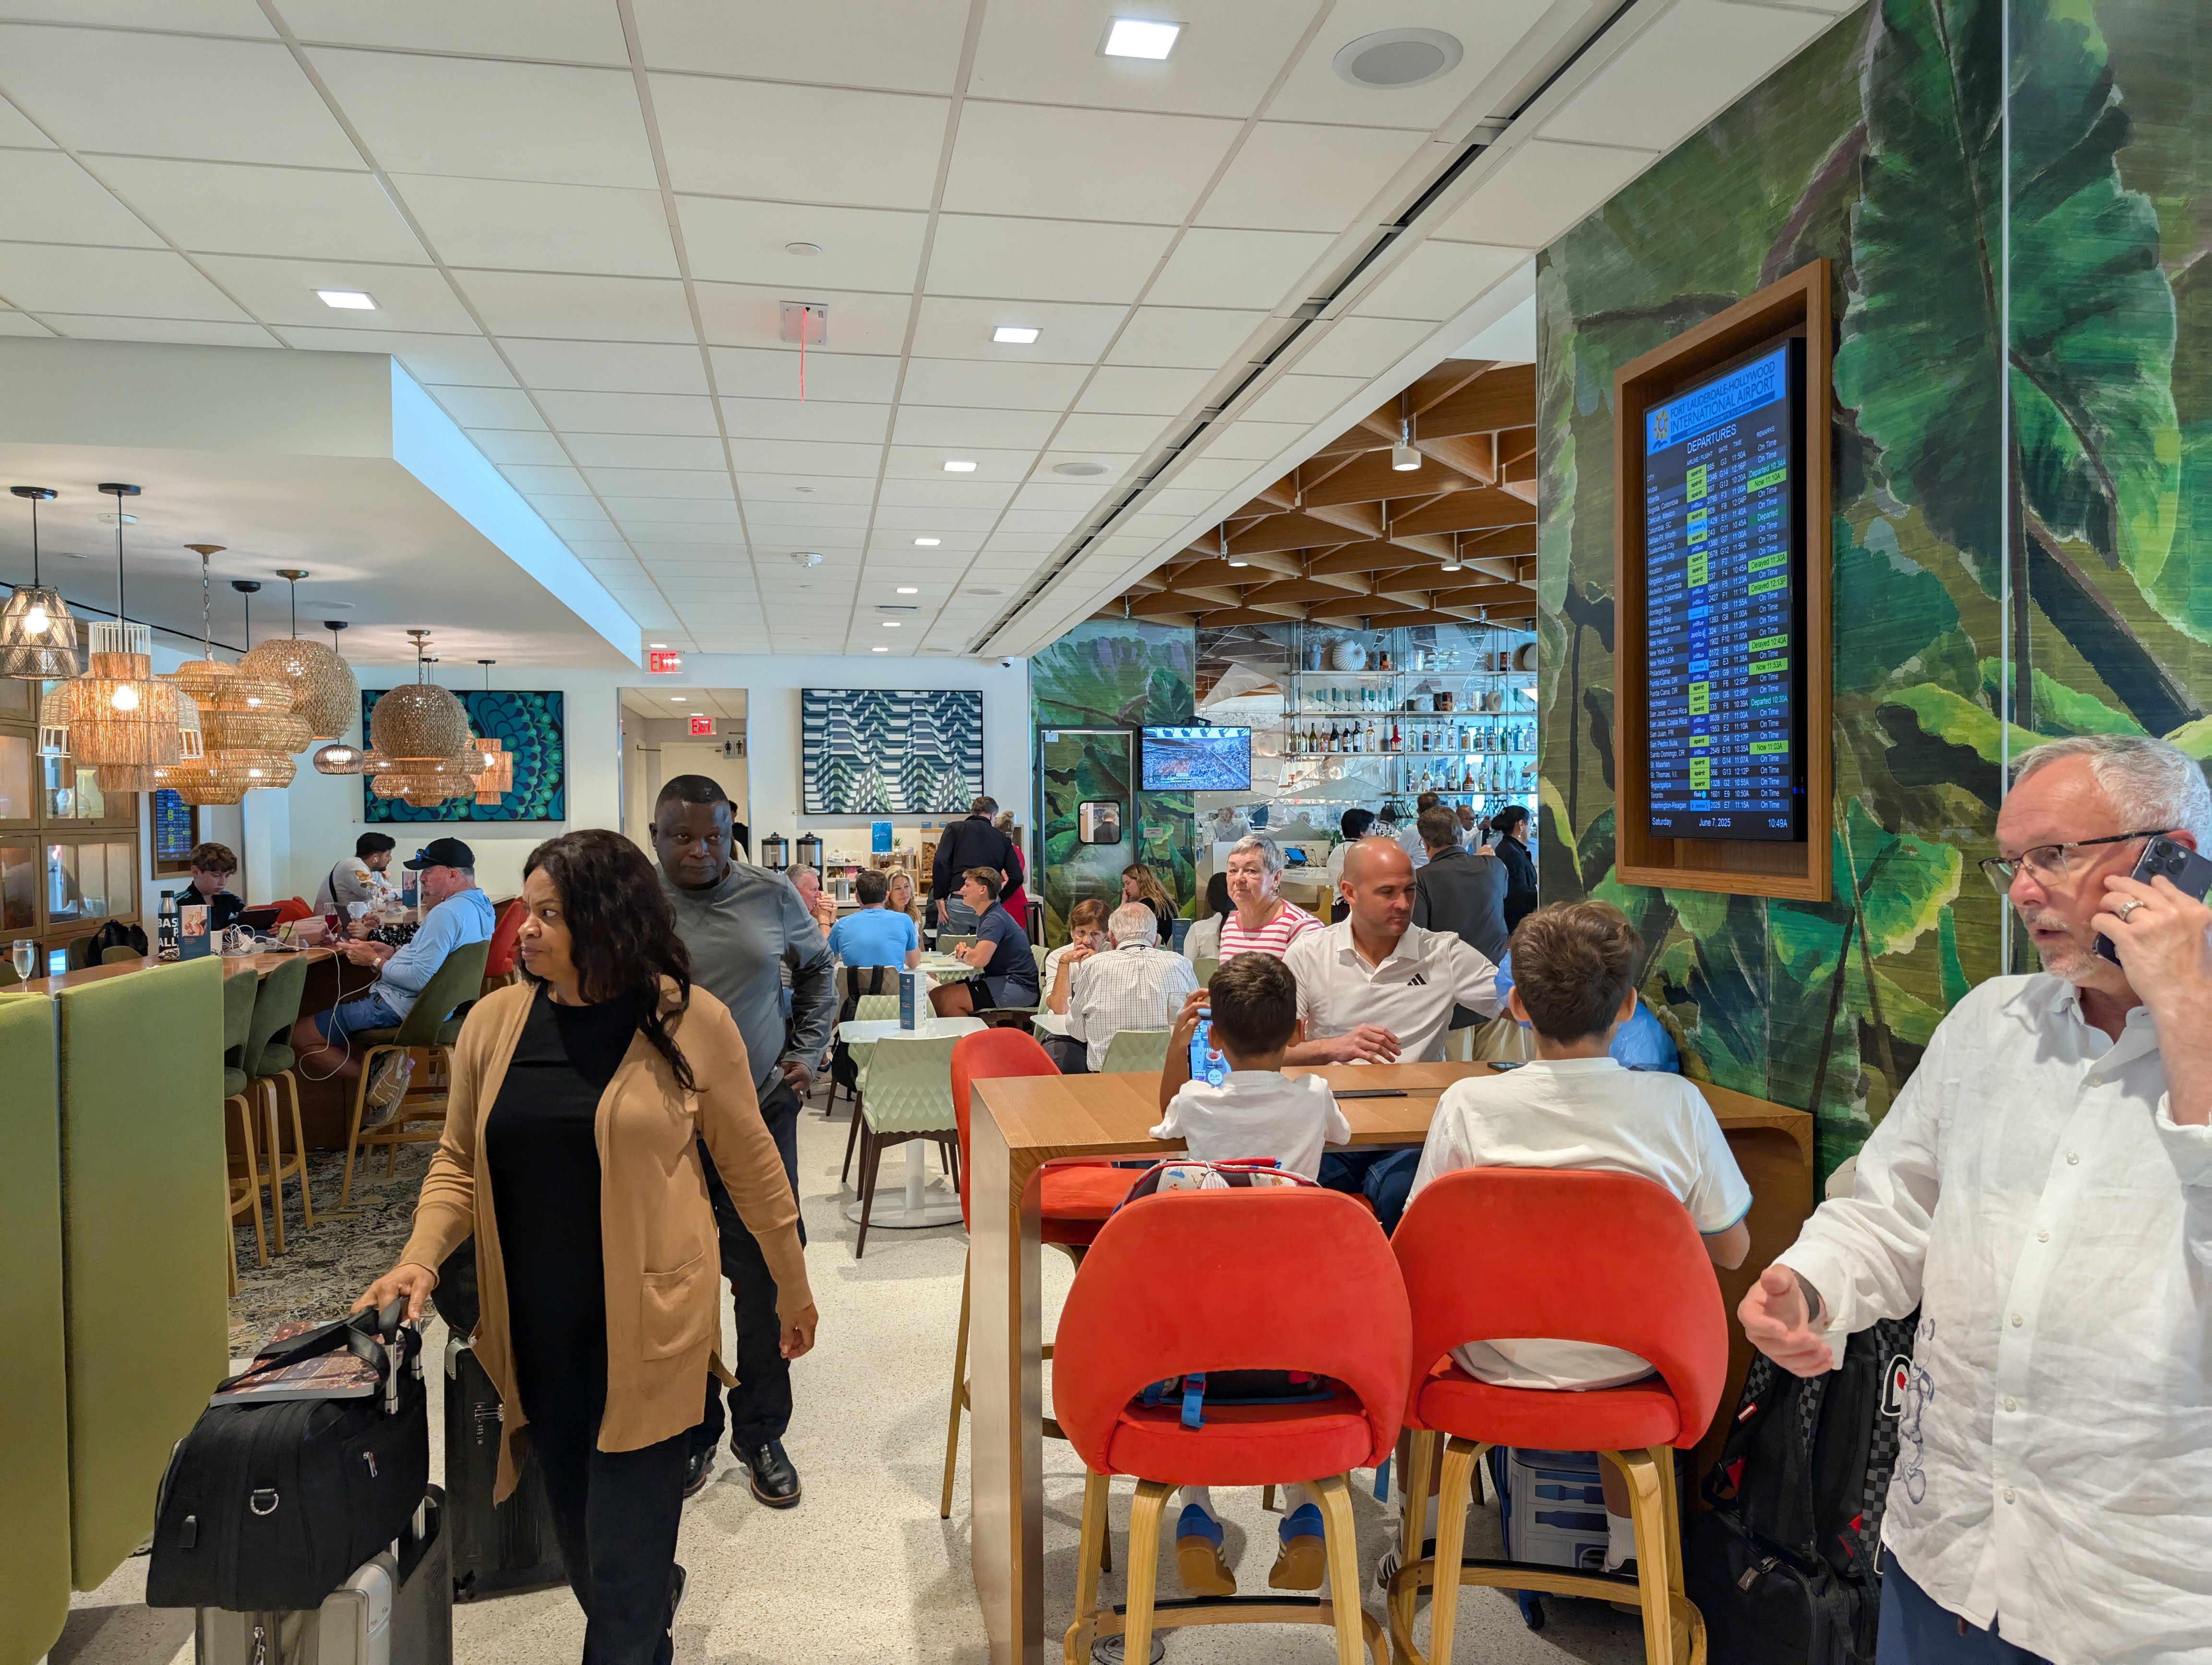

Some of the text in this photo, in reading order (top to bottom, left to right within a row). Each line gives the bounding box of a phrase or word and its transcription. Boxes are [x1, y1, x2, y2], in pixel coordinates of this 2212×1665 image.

[1670, 360, 1775, 418] FORT LAUDERDALE-HOLLYWOOD
[1671, 374, 1774, 433] INTERNATIONAL AIRPORT
[1687, 420, 1709, 435] BROWARD
[1731, 402, 1751, 416] FLORIDA
[1686, 456, 1698, 466] AIRLINE
[1701, 451, 1712, 460] FLIGHT
[1718, 445, 1728, 454] GATE
[1733, 439, 1742, 448] TIME
[1756, 426, 1775, 439] REMARKS
[1687, 423, 1735, 454] DEPARTURES
[1721, 458, 1726, 466] G3
[1732, 451, 1746, 461] 11:50A
[1758, 443, 1764, 452] On
[1766, 438, 1776, 448] Time
[1707, 450, 1776, 482] 2346 G14 12:16P On Time
[1720, 479, 1728, 488] G13
[1732, 473, 1746, 484] 10:20A
[1749, 464, 1769, 479] Departed
[1770, 458, 1785, 470] 10:34A
[1707, 495, 1717, 504] 2795
[1732, 485, 1746, 495] 11:00A
[1755, 478, 1764, 487] Now
[1766, 472, 1780, 483] 11:10A
[1732, 496, 1746, 506] 12:04P
[1758, 489, 1765, 498] On
[1766, 485, 1777, 495] Time
[1707, 517, 1717, 526] 1429
[1733, 507, 1746, 517] 11:40A
[1758, 501, 1765, 509] On
[1766, 497, 1777, 507] Time
[1733, 519, 1746, 529] 10:45A
[1758, 509, 1778, 522] Departed
[1708, 538, 1718, 547] 1380
[1733, 530, 1746, 540] 11:00A
[1758, 524, 1765, 532] On
[1766, 521, 1777, 530] Time
[1708, 532, 1777, 559] 2678 G12 11:56A On Time
[1733, 553, 1746, 562] 11:38A
[1767, 544, 1777, 553] Time
[1733, 554, 1785, 573] 10:45A Delayed 11:30A
[1733, 575, 1746, 584] 11:23A
[1767, 568, 1777, 576] Time
[1734, 577, 1785, 595] 11:11A Delayed 12:13P
[1734, 598, 1747, 607] 11:55A
[1767, 591, 1778, 599] Time
[1734, 609, 1747, 618] 11:00A
[1767, 603, 1778, 611] Time
[1734, 621, 1747, 629] 11:20A
[1734, 632, 1747, 641] 11:00A
[1767, 626, 1778, 634] Time
[1734, 637, 1786, 652] 10:00A Delayed 10:40A
[650, 653, 676, 672] EXIT
[1734, 666, 1747, 674] 11:41A
[1767, 661, 1782, 669] 11:53A
[1751, 697, 1770, 707] Departed
[692, 719, 712, 733] EXIT
[1652, 817, 1671, 827] Saturday
[1712, 818, 1717, 826] 7,
[1718, 818, 1730, 827] 2025
[1768, 819, 1787, 828] 10:49A
